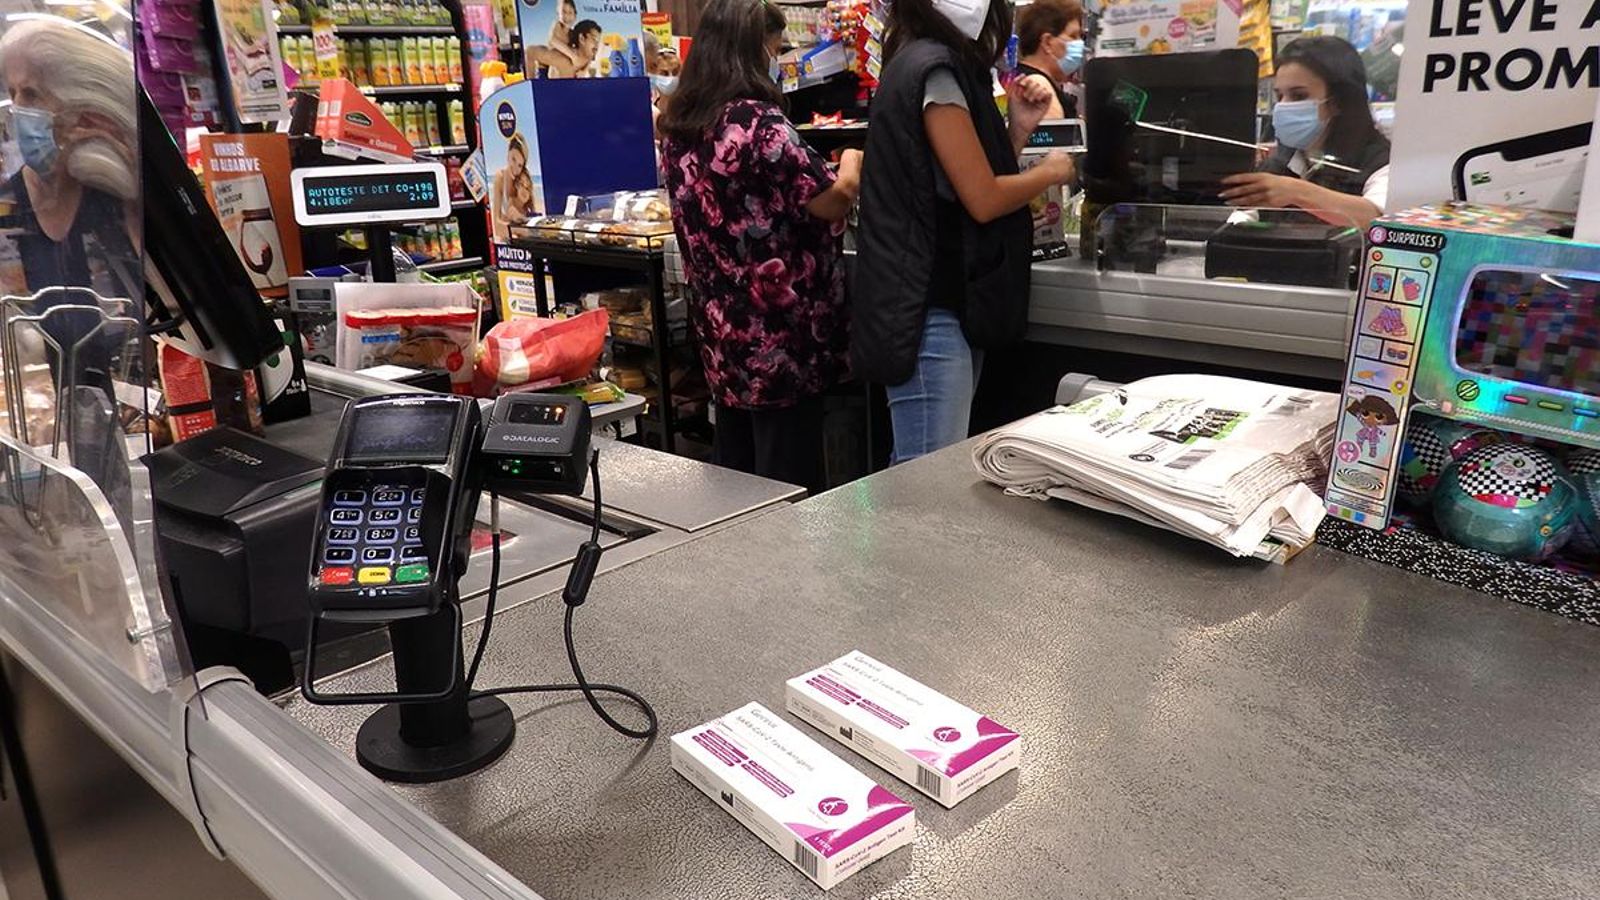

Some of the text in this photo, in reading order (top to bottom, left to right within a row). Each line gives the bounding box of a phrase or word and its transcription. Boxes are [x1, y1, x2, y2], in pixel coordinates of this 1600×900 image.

[1430, 0, 1557, 37] LEVE
[1423, 46, 1600, 93] PROM
[308, 185, 366, 198] AUTOTESTE
[371, 183, 390, 194] DET
[409, 191, 434, 201] 2.09
[1387, 231, 1437, 249] SURPRISES
[497, 246, 524, 260] MUITO
[371, 529, 380, 539] 8
[409, 528, 418, 537] 9
[367, 550, 377, 559] 0
